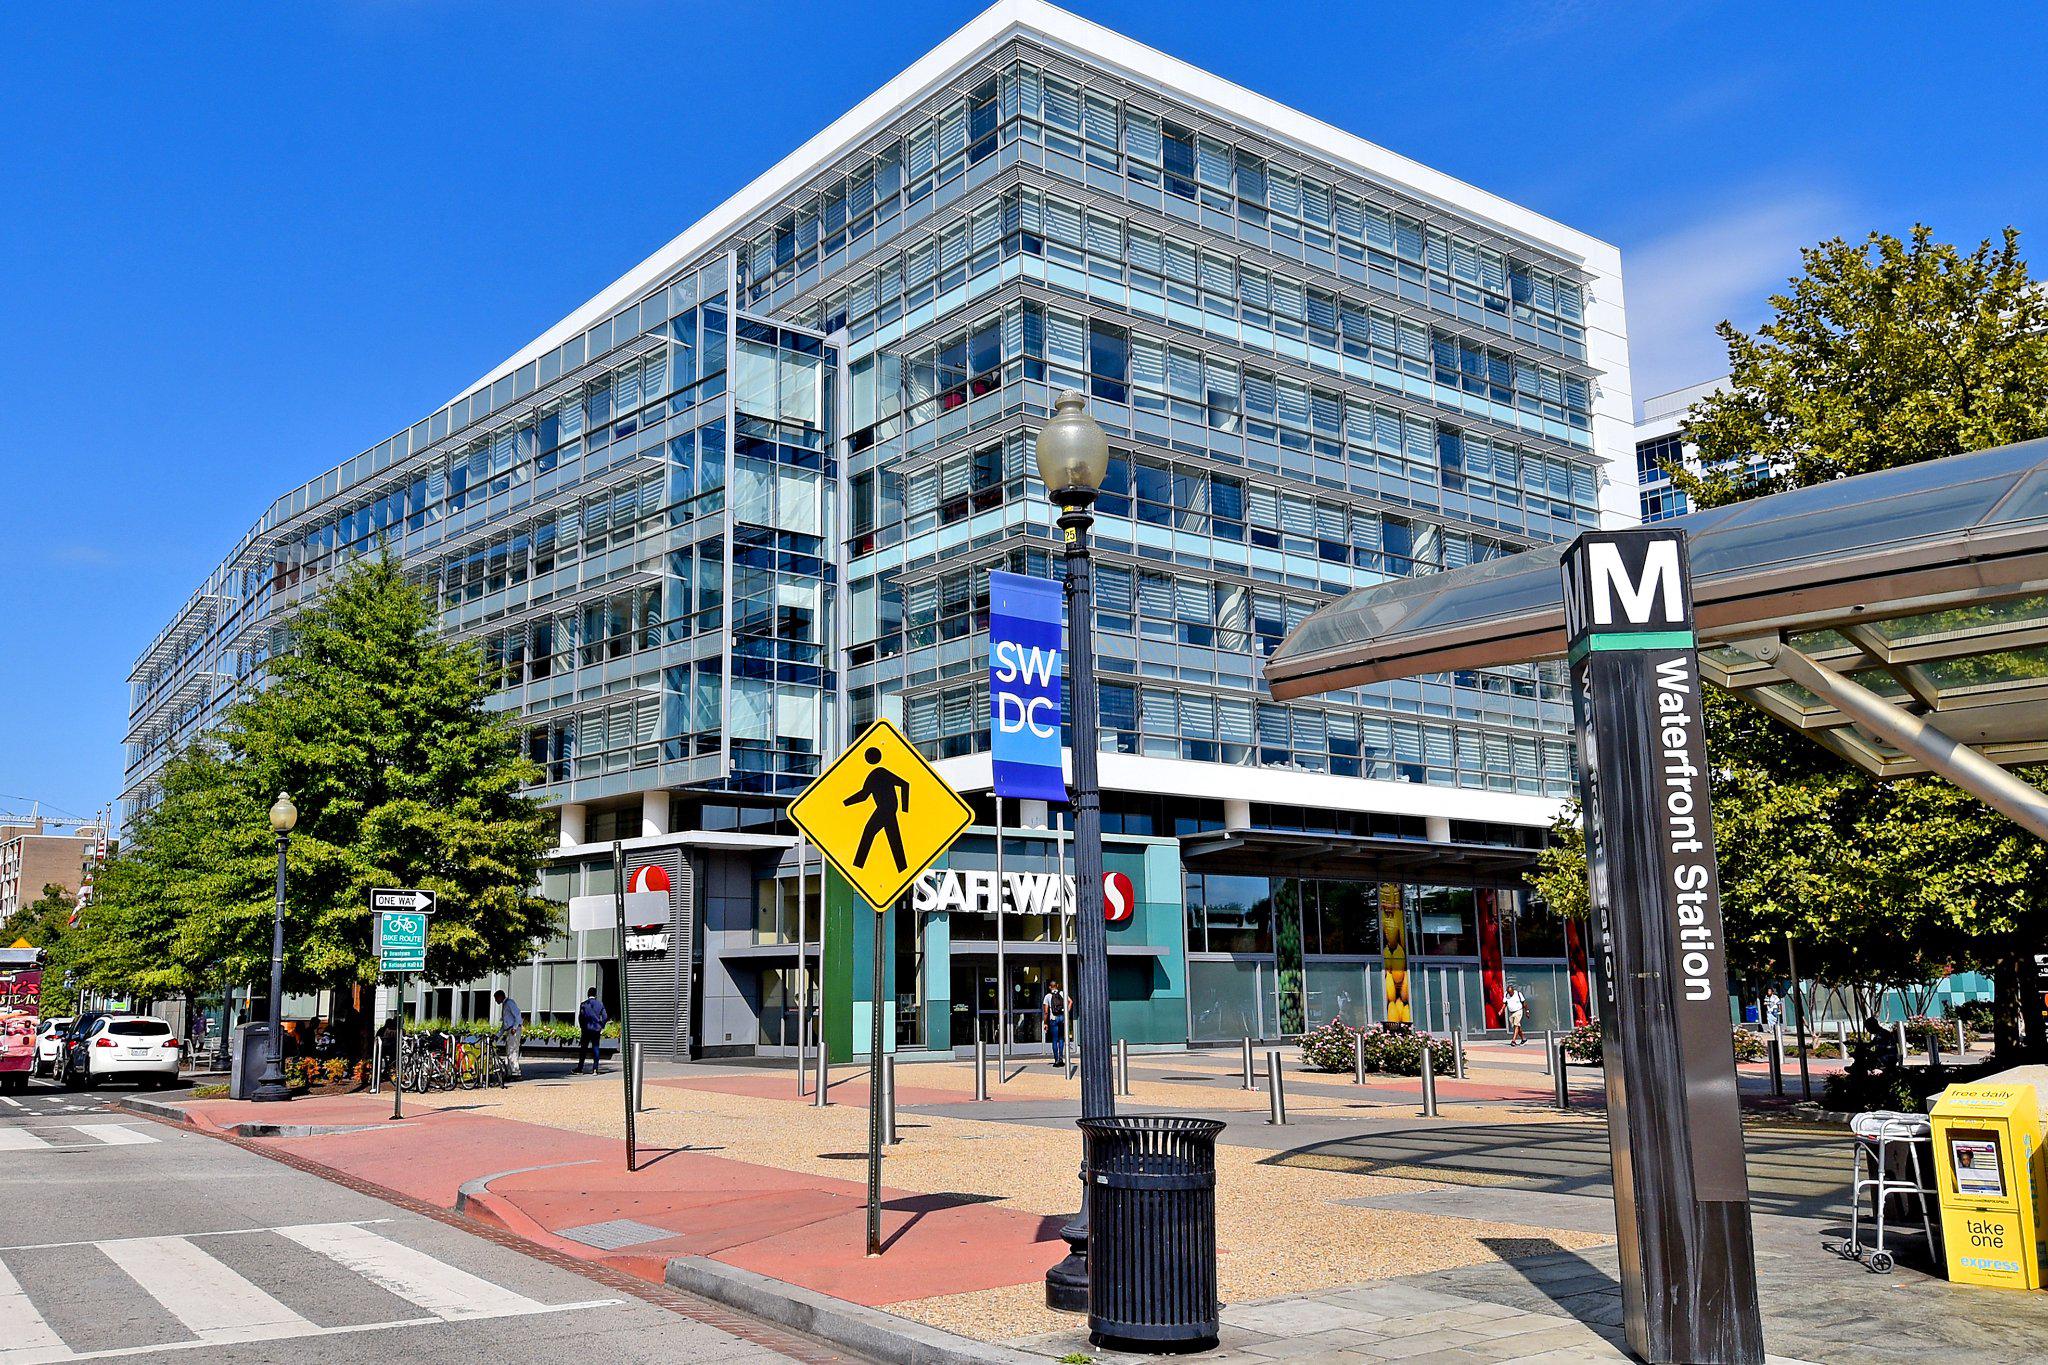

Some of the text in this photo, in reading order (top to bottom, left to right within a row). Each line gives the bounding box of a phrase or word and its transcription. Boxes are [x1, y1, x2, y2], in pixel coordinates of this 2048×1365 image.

[1588, 540, 1685, 625] M
[1562, 547, 1587, 643] M
[995, 640, 1057, 688] SW
[998, 691, 1055, 739] DC
[1656, 656, 1715, 1001] Waterfront Station
[378, 896, 416, 905] ONE WAY
[383, 934, 398, 942] BIKE
[399, 935, 422, 943] ROUTE
[1981, 1091, 2014, 1099] daily
[1967, 1219, 2004, 1236] take
[1971, 1235, 2004, 1248] one
[1960, 1256, 2019, 1272] express
